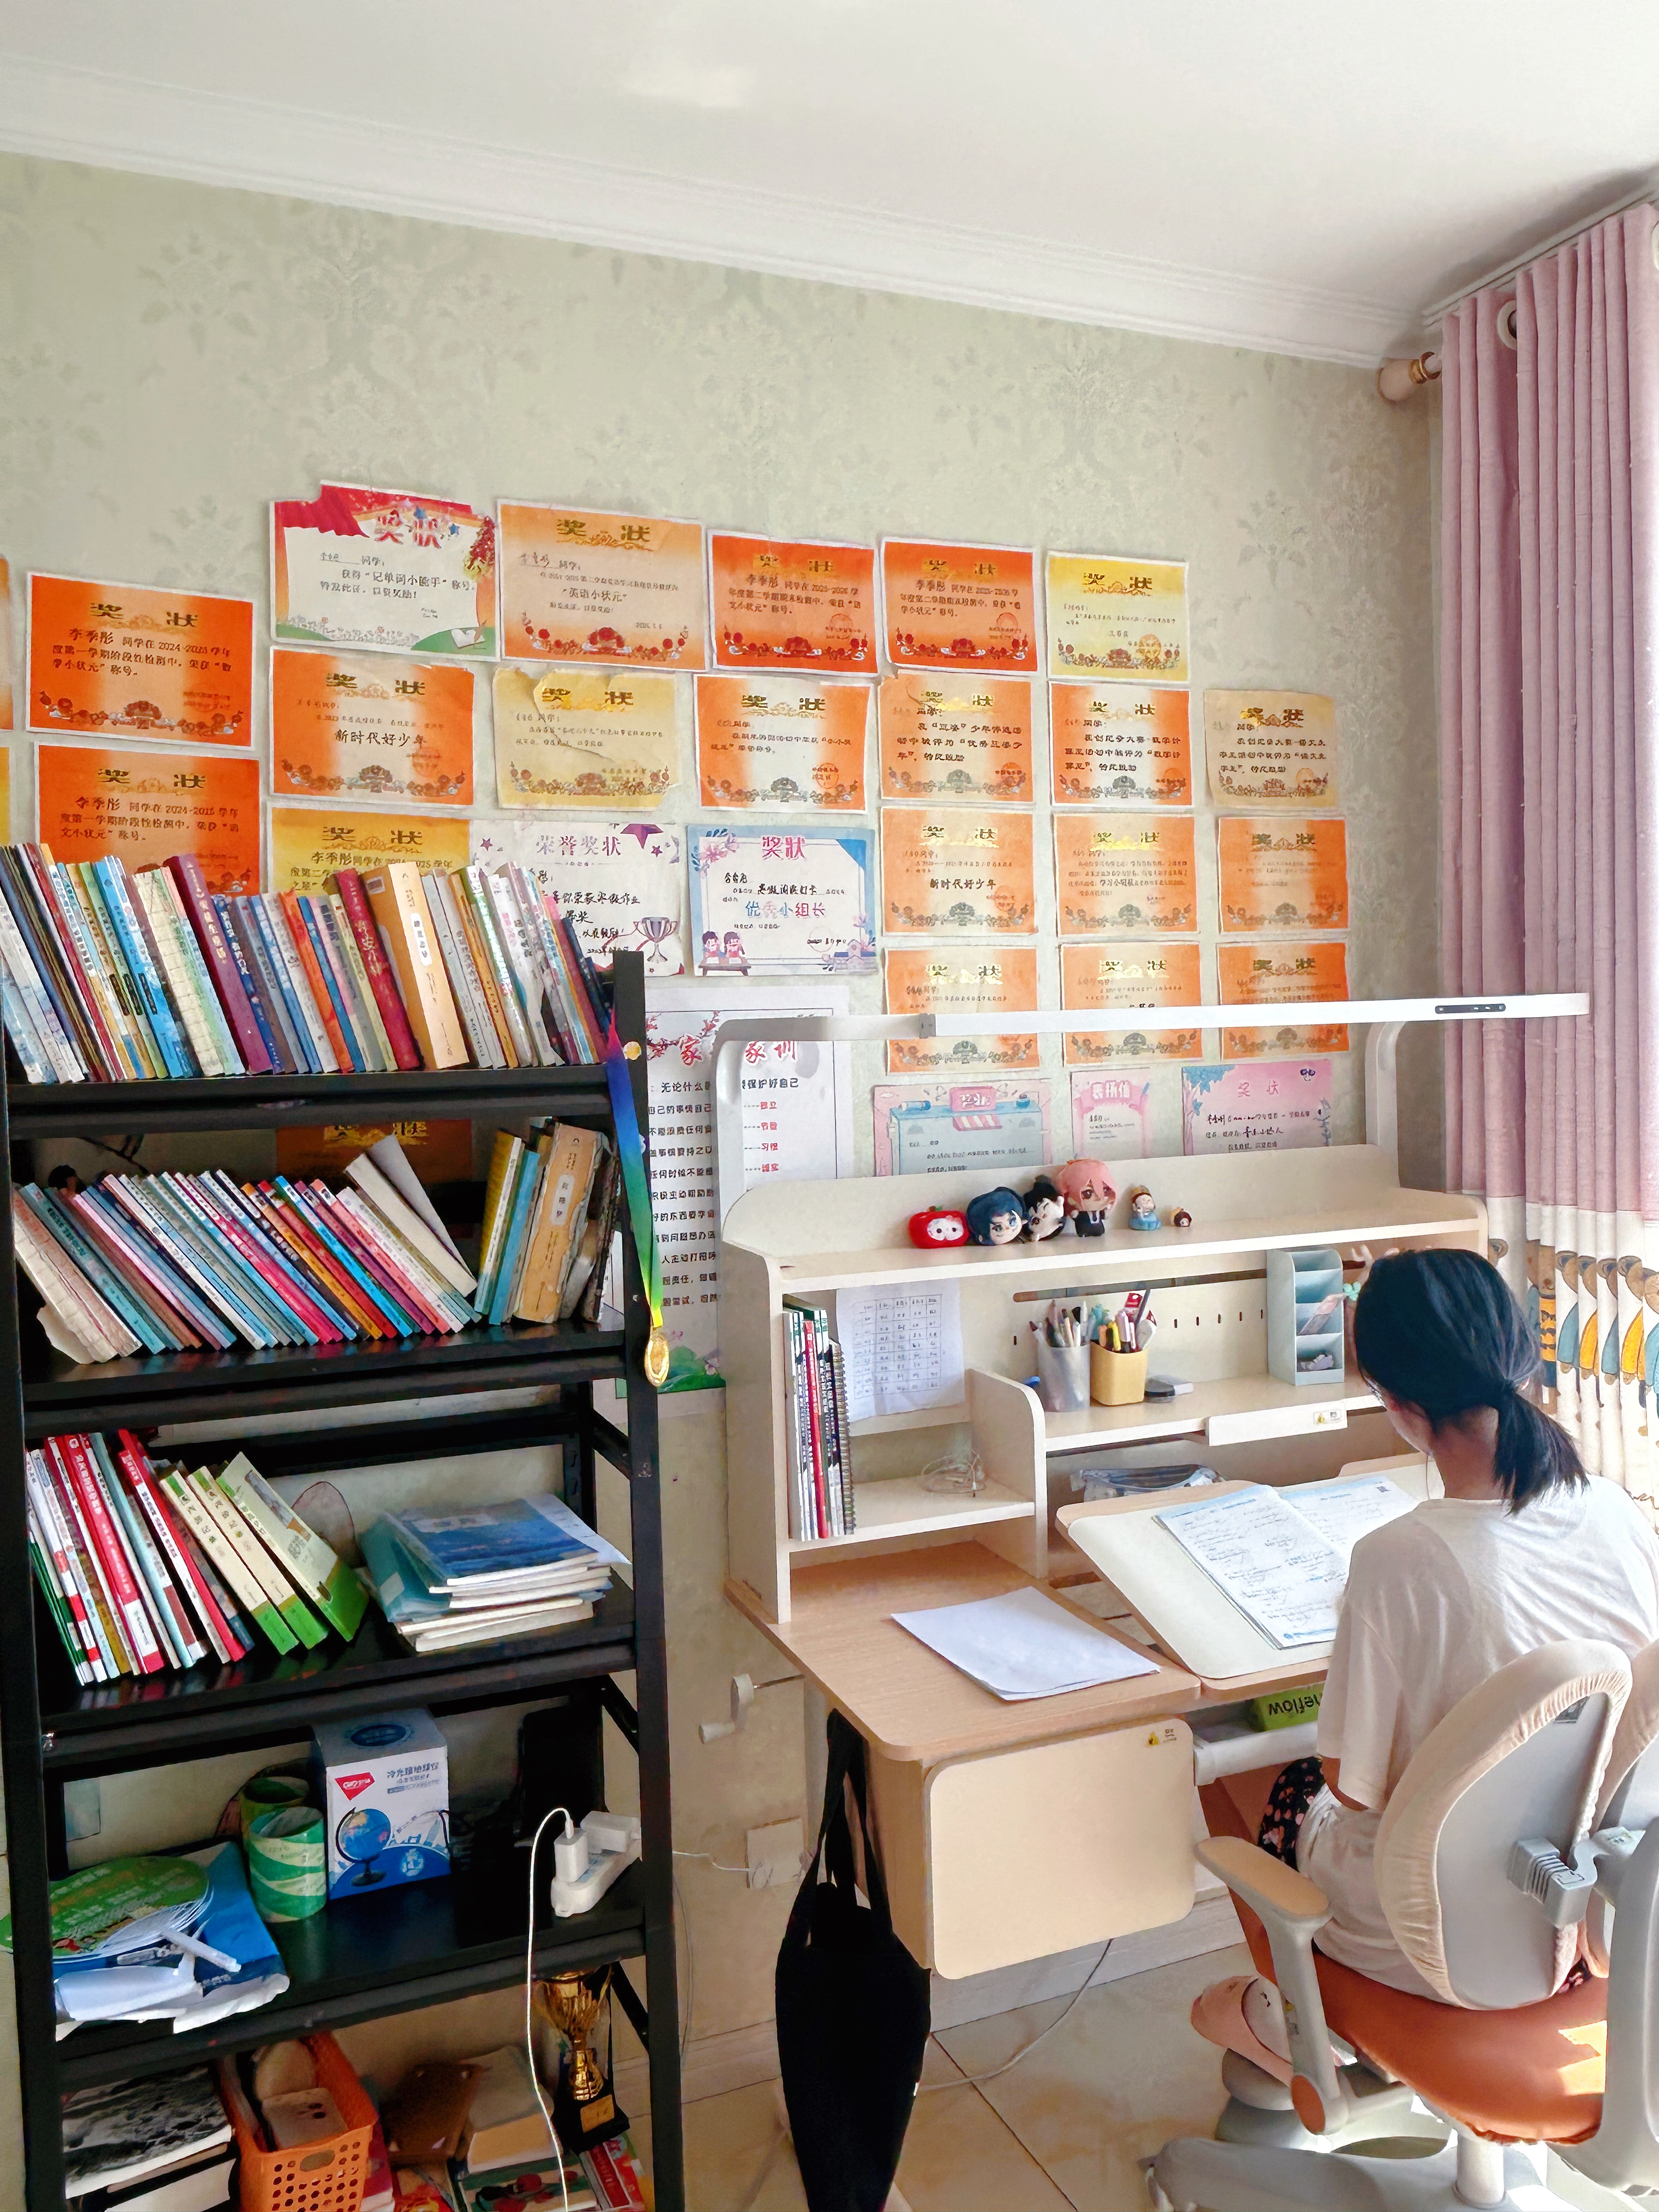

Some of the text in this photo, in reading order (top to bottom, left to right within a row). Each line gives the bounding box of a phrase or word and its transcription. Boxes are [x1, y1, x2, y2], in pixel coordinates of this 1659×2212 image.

[556, 519, 650, 542] 奖状
[1082, 572, 1153, 590] 奖状
[90, 602, 199, 628] 奖状
[326, 673, 426, 695] 奖状
[541, 687, 634, 706] 奖状
[741, 695, 826, 711] 奖状
[334, 729, 427, 750] 新时代好少年
[98, 769, 206, 789] 奖状
[321, 826, 424, 847] 奖状
[922, 826, 997, 839] 奖状
[536, 834, 622, 856] 荣誉奖状
[761, 836, 808, 861] 奖状
[930, 878, 997, 890] 新时代好少年
[745, 900, 826, 919] 优秀小组长
